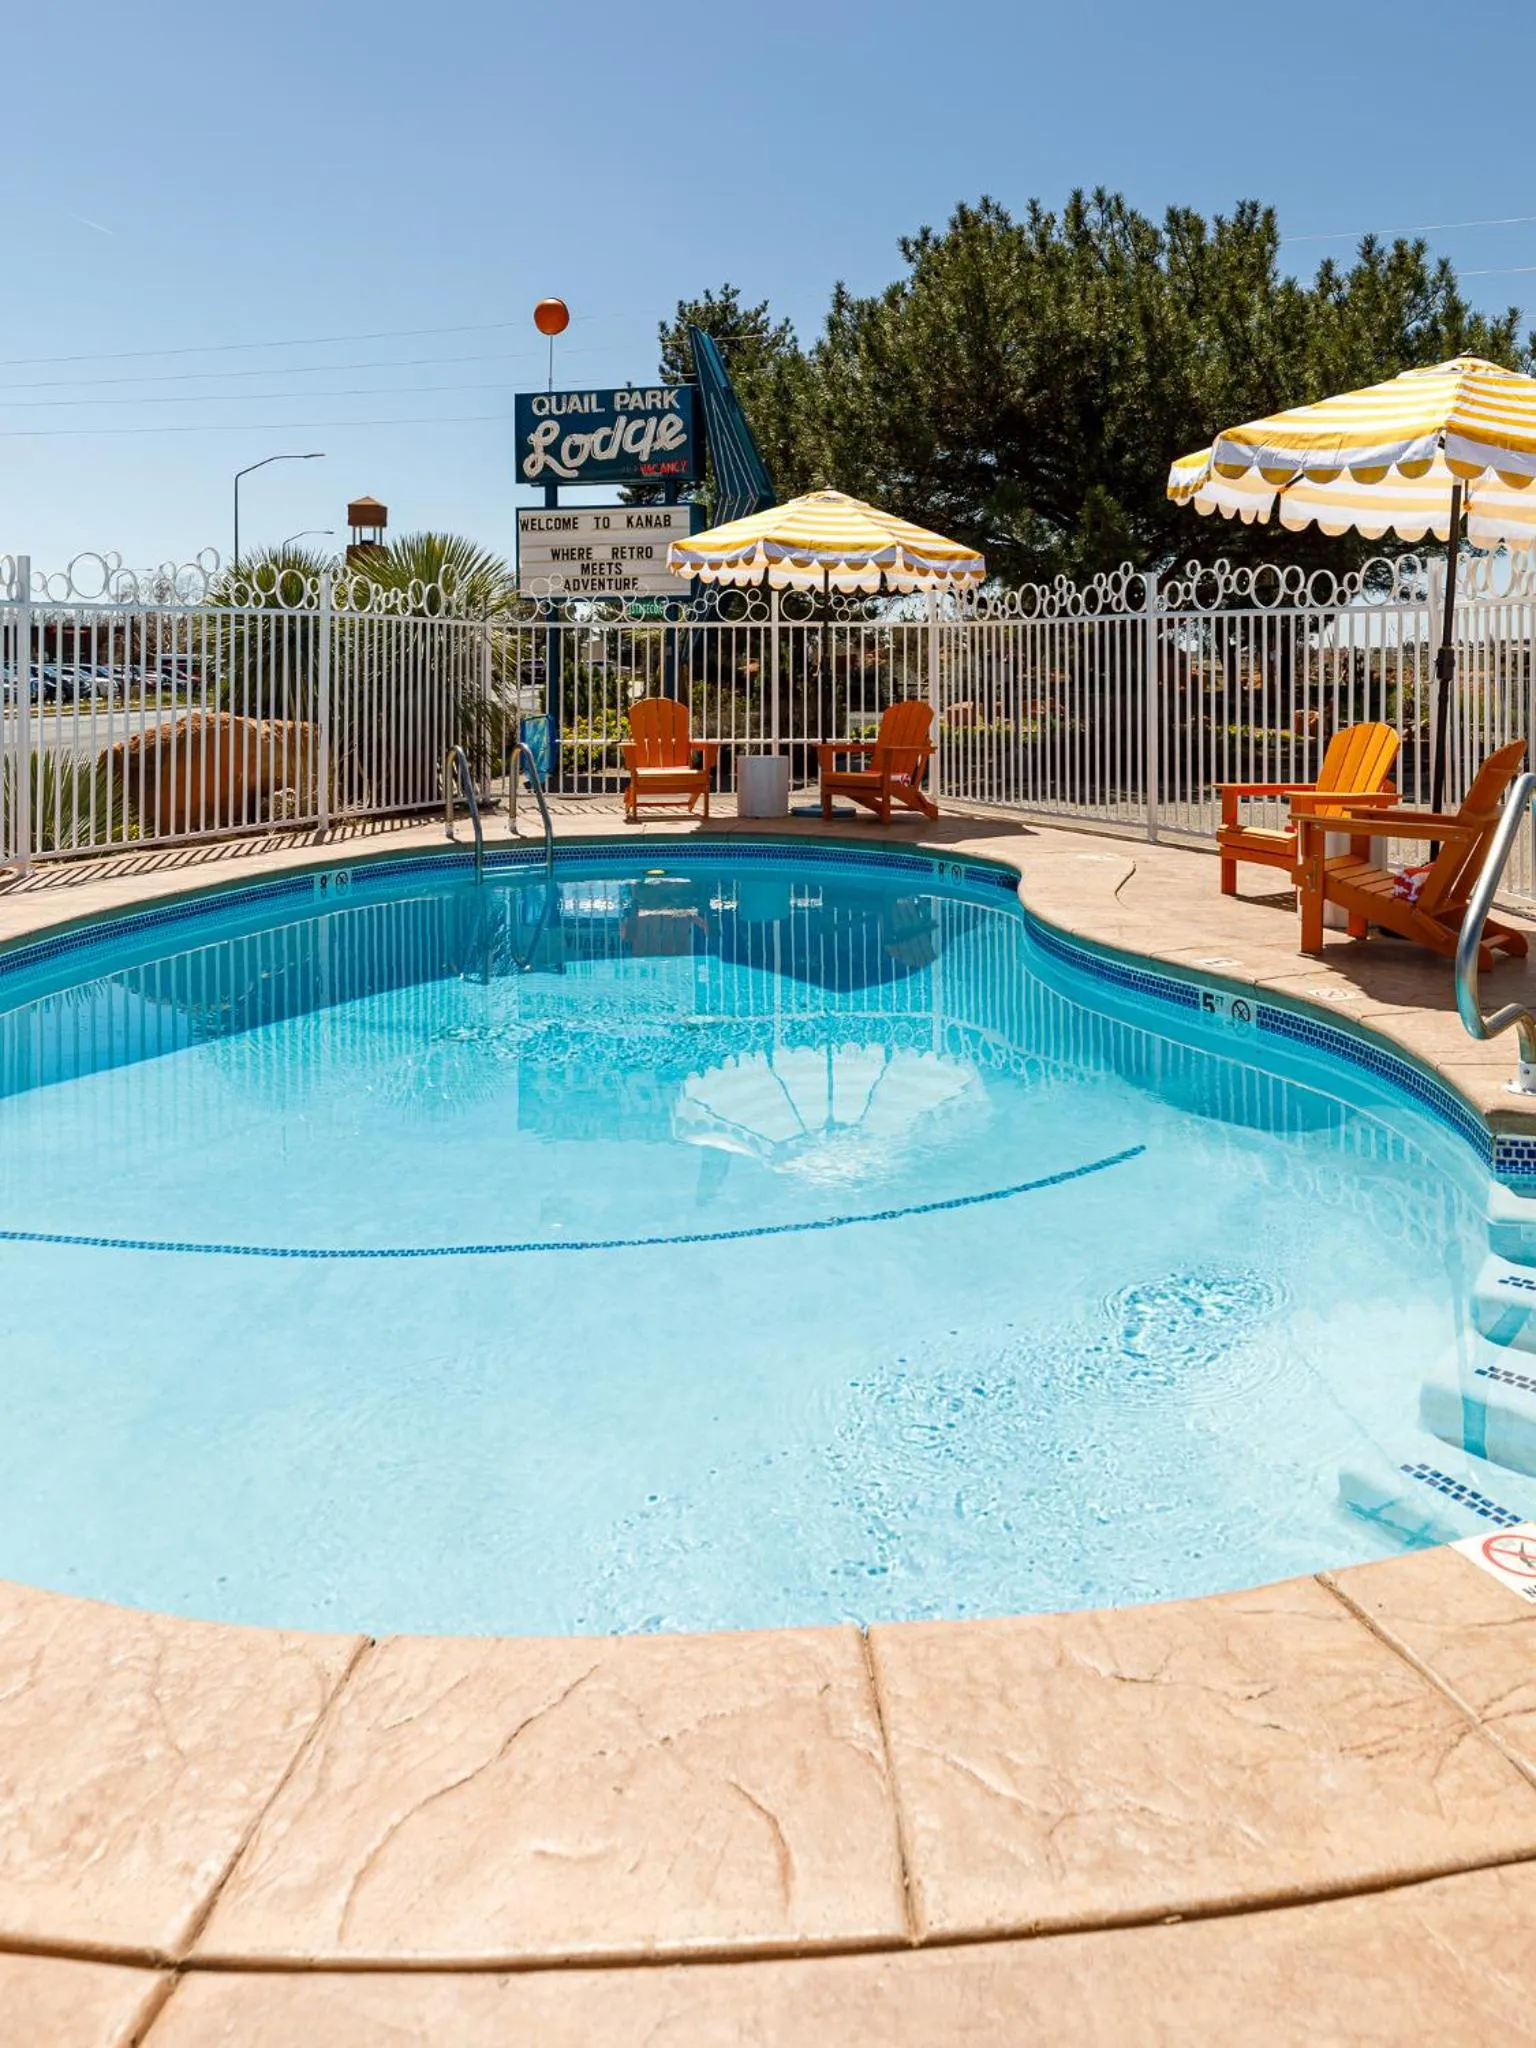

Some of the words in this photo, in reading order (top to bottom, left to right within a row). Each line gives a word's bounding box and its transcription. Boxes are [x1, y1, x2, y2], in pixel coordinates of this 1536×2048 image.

[532, 393, 605, 416] QUAIL
[614, 389, 680, 411] PARK
[522, 413, 687, 479] Lodge
[640, 461, 688, 476] VACANCY
[520, 517, 579, 531] WELCOME
[594, 516, 610, 529] TO
[626, 514, 672, 529] KANAB
[551, 547, 592, 561] WHERE
[611, 546, 653, 560] RETRO
[581, 562, 622, 576] MEETS
[563, 577, 639, 592] ADVENTURE
[1202, 992, 1215, 1014] 5
